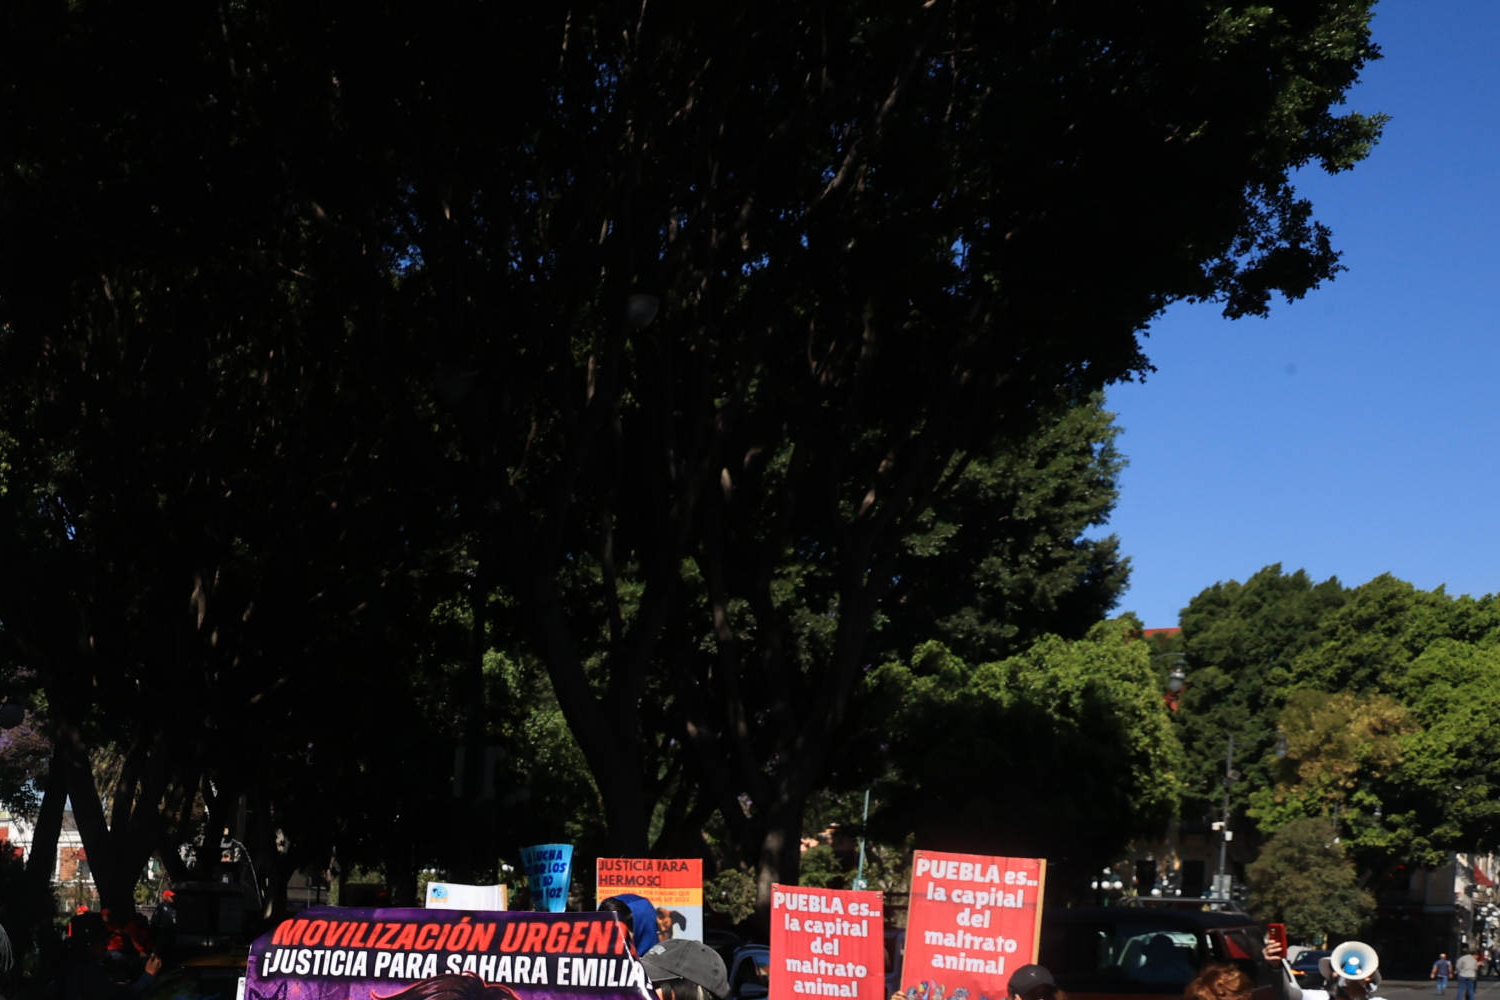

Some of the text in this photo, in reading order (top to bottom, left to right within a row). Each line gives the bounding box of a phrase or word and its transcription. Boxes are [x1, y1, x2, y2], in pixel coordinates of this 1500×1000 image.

[599, 860, 653, 871] JUSTICIA
[915, 858, 1000, 884] PUEBLA
[773, 891, 845, 915] PUEBLA
[926, 882, 1025, 909] la capital
[784, 913, 869, 938] la capital
[956, 908, 991, 928] del
[271, 916, 632, 956] MOVILIZACIÓN URGENT
[810, 937, 839, 956] del
[924, 930, 1018, 953] maltrato
[262, 949, 367, 977] ¡JUSTICIA
[374, 952, 438, 979] PARA
[445, 954, 549, 986] SAHARA
[786, 957, 868, 979] maltrato
[931, 952, 1005, 975] animal
[793, 978, 858, 998] animal
